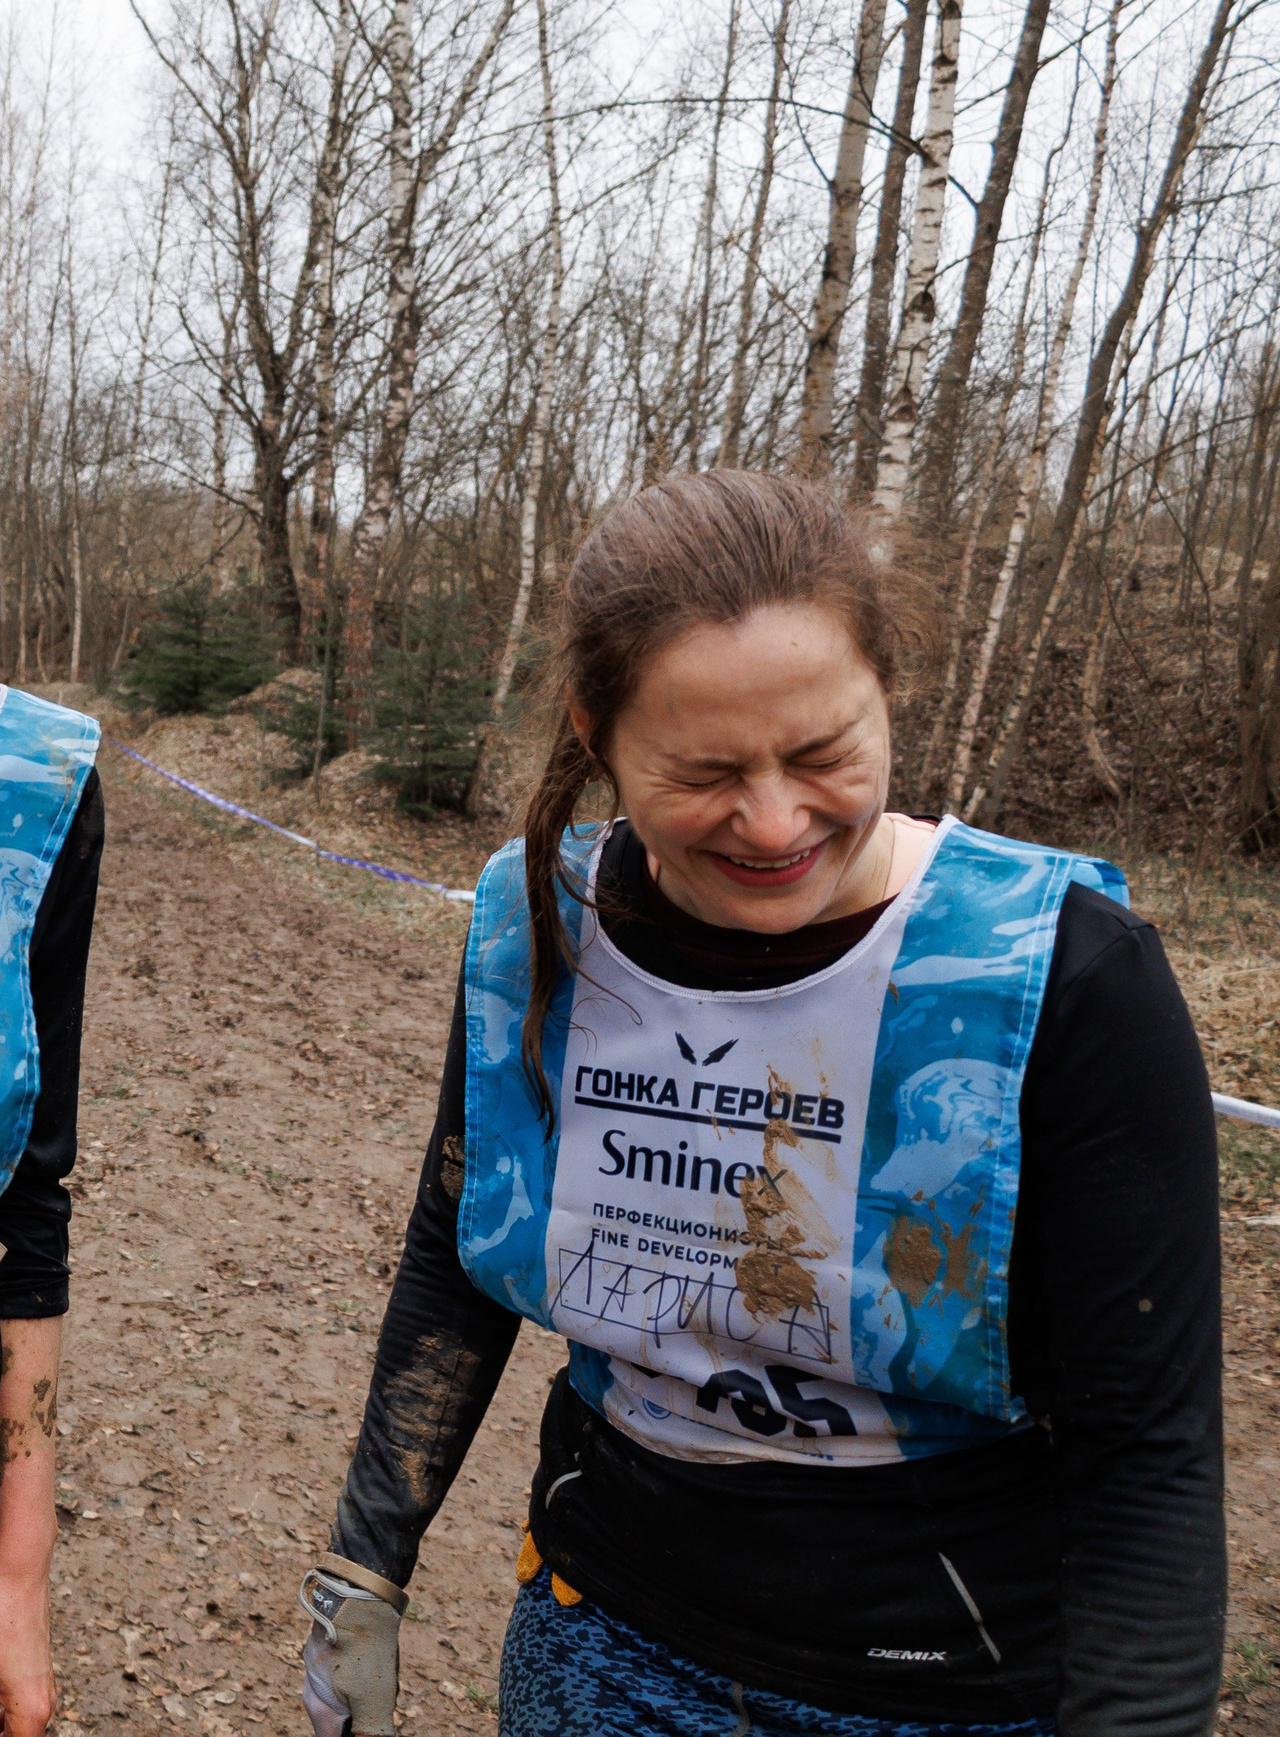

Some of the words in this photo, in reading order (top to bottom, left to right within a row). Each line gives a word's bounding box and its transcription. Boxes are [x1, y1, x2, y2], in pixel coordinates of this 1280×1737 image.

[574, 1065, 680, 1108] ГОНКА
[690, 1080, 845, 1130] ГЕРОЕВ
[598, 1128, 788, 1202] Sminex
[591, 1228, 629, 1249] FINE
[867, 1648, 947, 1661] DEMIX
